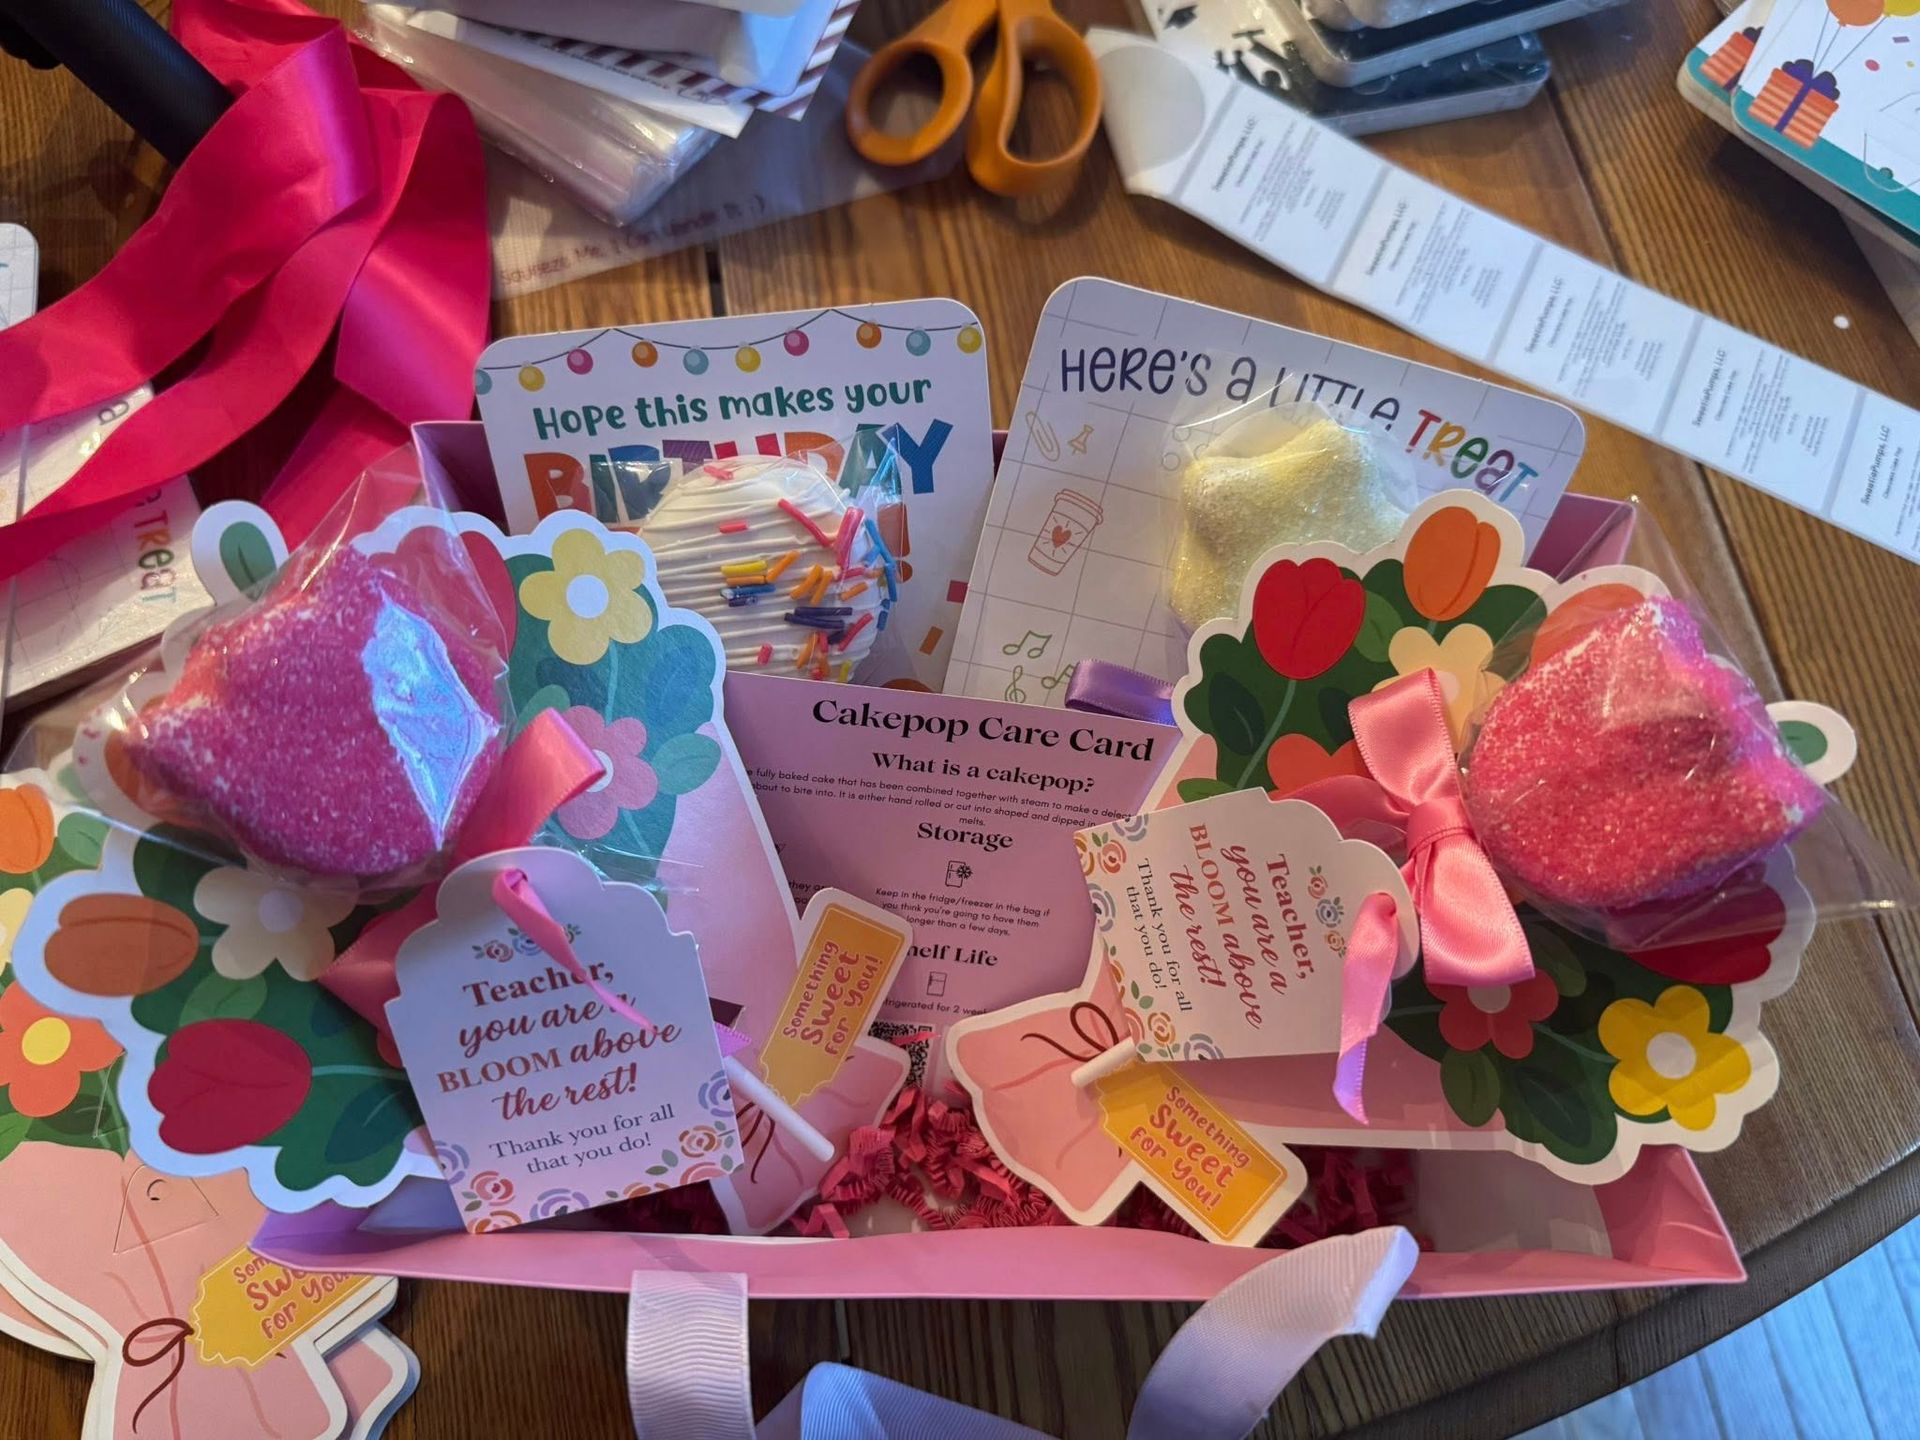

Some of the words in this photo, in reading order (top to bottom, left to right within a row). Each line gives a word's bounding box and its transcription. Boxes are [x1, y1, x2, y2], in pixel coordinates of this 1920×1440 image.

[634, 392, 709, 431] this
[718, 380, 834, 419] makes
[840, 376, 932, 413] your
[1878, 424, 1891, 442] LLC
[812, 700, 969, 743] Cakepop
[978, 716, 1060, 747] Care
[1069, 728, 1154, 761] Card
[756, 768, 777, 780] fully
[778, 771, 809, 782] baked
[811, 774, 835, 784] cake
[838, 776, 857, 786] that
[860, 778, 877, 789] has
[879, 781, 904, 791] been
[905, 783, 953, 796] combined
[956, 789, 997, 801] together
[999, 794, 1018, 804] with
[1021, 797, 1049, 808] steam
[1052, 801, 1062, 810] to
[1064, 803, 1090, 815] make
[872, 752, 936, 773] What
[942, 760, 961, 776] is
[967, 765, 981, 779] a
[986, 765, 1095, 795] cakepop?
[781, 785, 791, 794] to
[793, 786, 813, 796] bite
[815, 788, 836, 798] into.
[839, 790, 846, 798] It
[849, 792, 856, 800] is
[858, 792, 886, 803] either
[888, 795, 913, 806] hand
[914, 798, 942, 808] rolled
[943, 802, 954, 810] or
[956, 802, 971, 812] cut
[974, 804, 992, 814] into
[994, 806, 1029, 820] shaped
[1031, 811, 1050, 822] and
[1052, 814, 1085, 829] dipped
[959, 816, 986, 827] melts.
[916, 821, 1014, 852] Storage
[875, 887, 899, 899] Keep
[901, 889, 910, 899] in
[912, 890, 926, 901] the
[928, 892, 993, 911] fridge/freezer
[995, 902, 1004, 911] in
[1006, 903, 1021, 913] the
[1023, 905, 1041, 918] bag
[1043, 908, 1050, 917] if
[882, 901, 898, 912] you
[900, 901, 921, 913] think
[923, 905, 950, 918] you're
[952, 907, 979, 922] going
[981, 911, 991, 921] to
[993, 912, 1015, 924] have
[1017, 916, 1039, 928] them
[906, 914, 935, 928] longer
[937, 918, 958, 929] than
[960, 922, 966, 930] a
[968, 922, 986, 932] few
[987, 925, 1011, 937] days.
[1126, 885, 1145, 921] that
[1169, 864, 1201, 924] the
[1185, 924, 1227, 989] rest!
[1188, 822, 1235, 928] BLOOM
[1222, 932, 1263, 1030] above
[1220, 845, 1262, 909] you
[1251, 912, 1280, 969] are
[1269, 974, 1289, 996] a
[1266, 853, 1314, 980] Teacher,
[907, 944, 950, 960] helf
[954, 947, 998, 966] Life
[1133, 919, 1154, 959] you
[1136, 858, 1163, 925] Thank
[1151, 922, 1172, 958] you
[1165, 960, 1181, 989] for
[1175, 991, 1192, 1012] all
[783, 941, 838, 1038] Something
[800, 951, 859, 1045] Sweet
[844, 955, 883, 1007] you!
[1149, 961, 1168, 990] do!
[459, 1015, 535, 1058] you
[541, 1001, 604, 1030] are
[936, 1002, 951, 1012] for
[952, 1004, 960, 1014] 2
[437, 1048, 561, 1093] BLOOM
[570, 1024, 682, 1063] above
[492, 1086, 561, 1121] the
[565, 1063, 638, 1106] rest!
[489, 1126, 563, 1159] Thank
[568, 1122, 607, 1150] you
[613, 1113, 644, 1134] for
[649, 1104, 675, 1124] all
[526, 1153, 569, 1174] that
[573, 1146, 613, 1171] you
[618, 1132, 651, 1157] do!
[1150, 1104, 1234, 1188] Sweet
[1166, 1086, 1250, 1168] Something
[1171, 1157, 1222, 1211] you!
